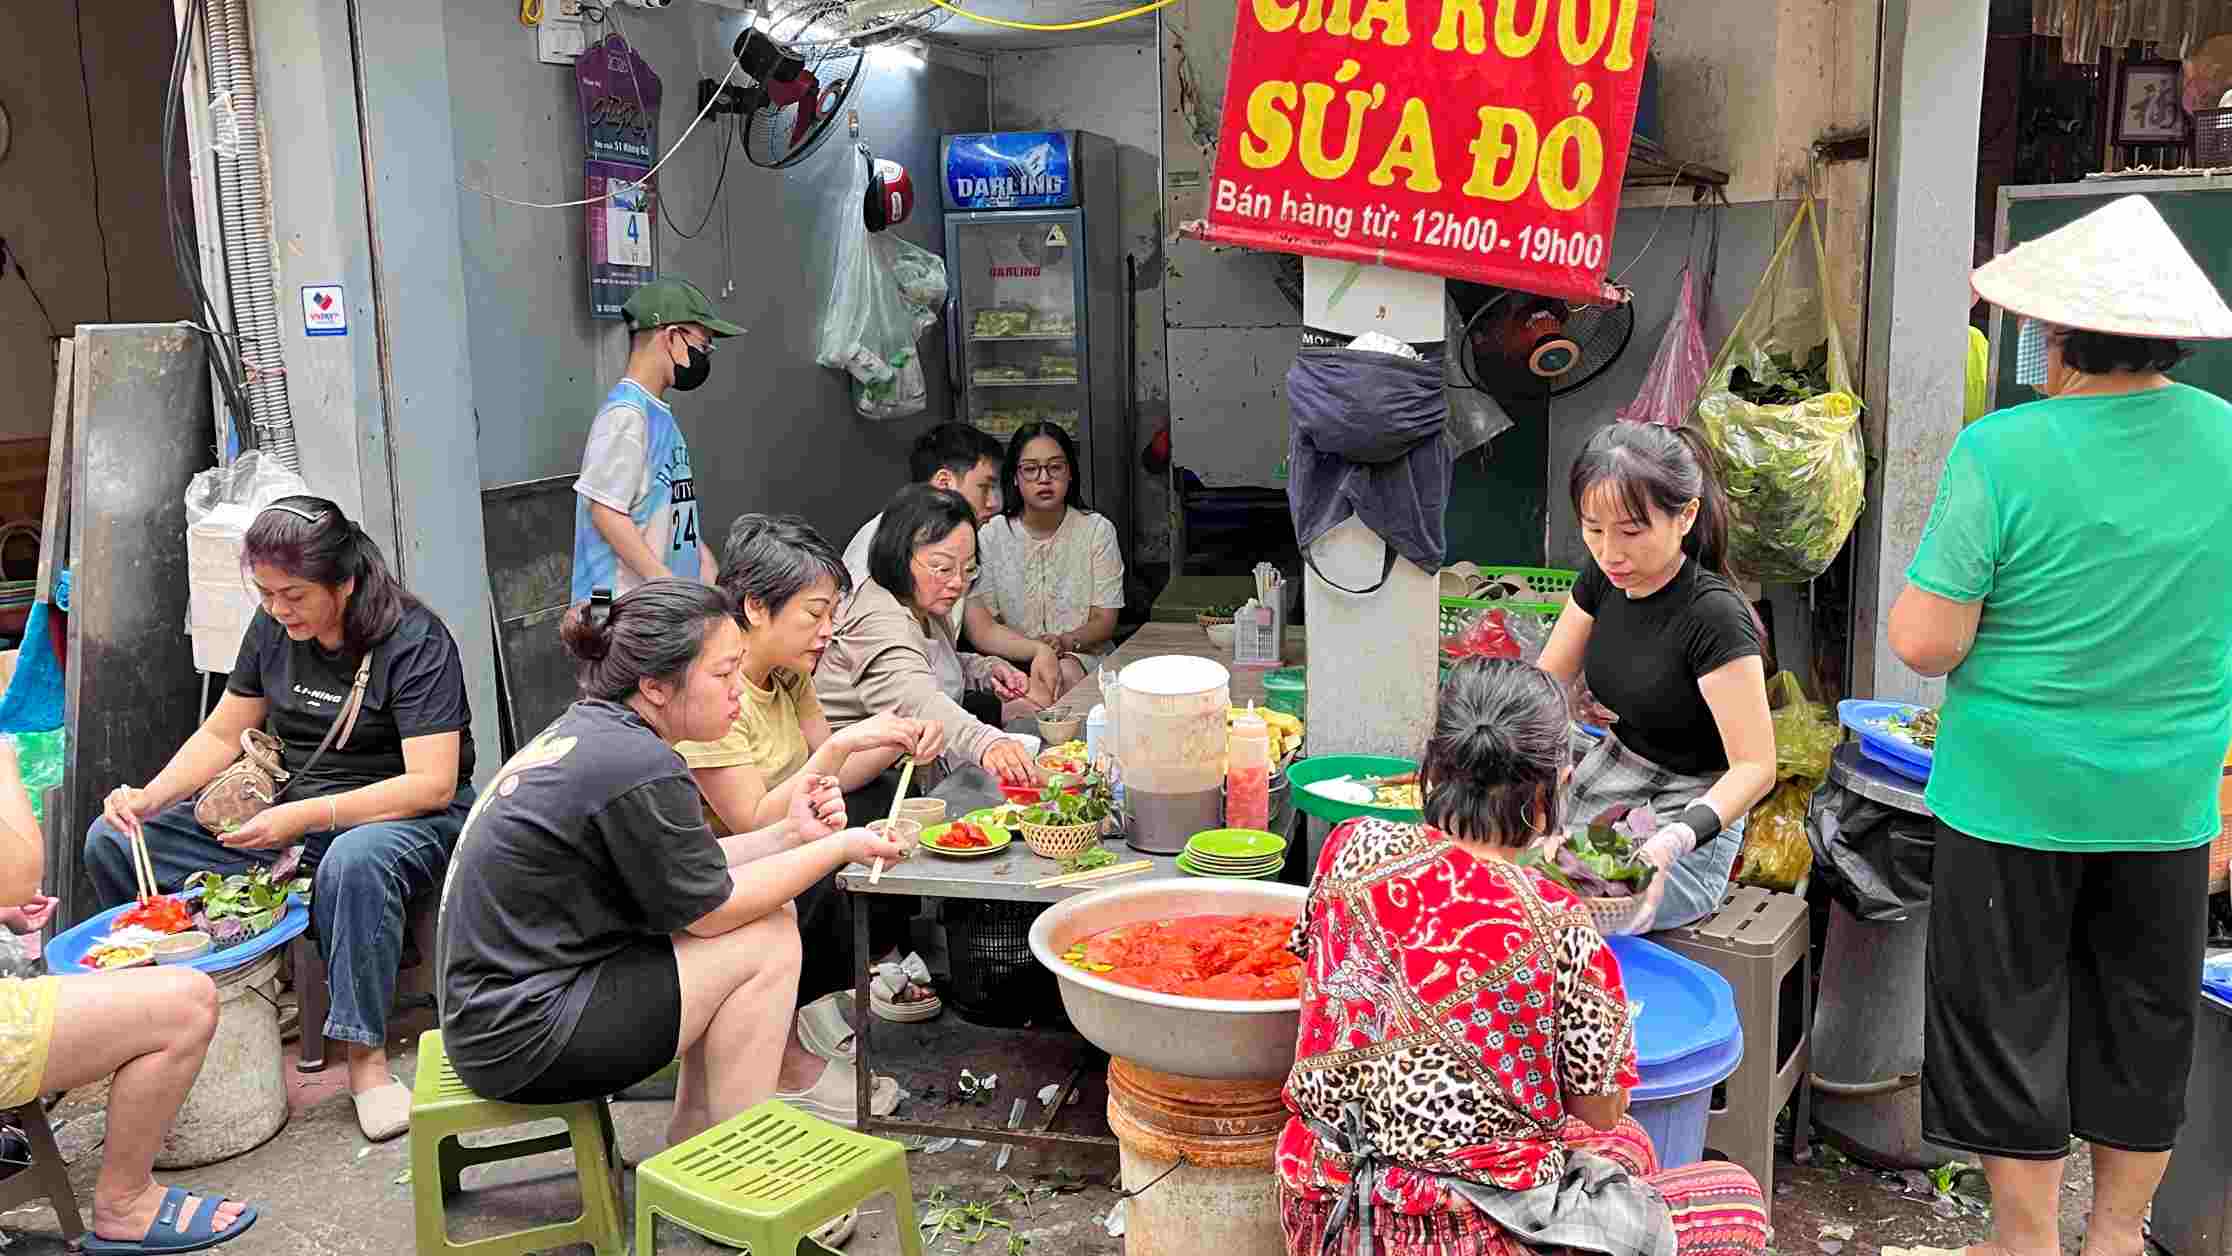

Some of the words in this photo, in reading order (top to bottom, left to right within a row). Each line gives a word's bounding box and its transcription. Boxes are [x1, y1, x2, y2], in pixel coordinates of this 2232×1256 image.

[1240, 58, 1442, 193] SỨA
[1462, 82, 1604, 211] ĐỎ
[957, 174, 1063, 199] DARLING
[627, 213, 639, 245] 4
[1215, 178, 1272, 220] Bán
[1280, 189, 1353, 239] hàng
[1361, 203, 1400, 240] từ:
[672, 507, 697, 551] 24
